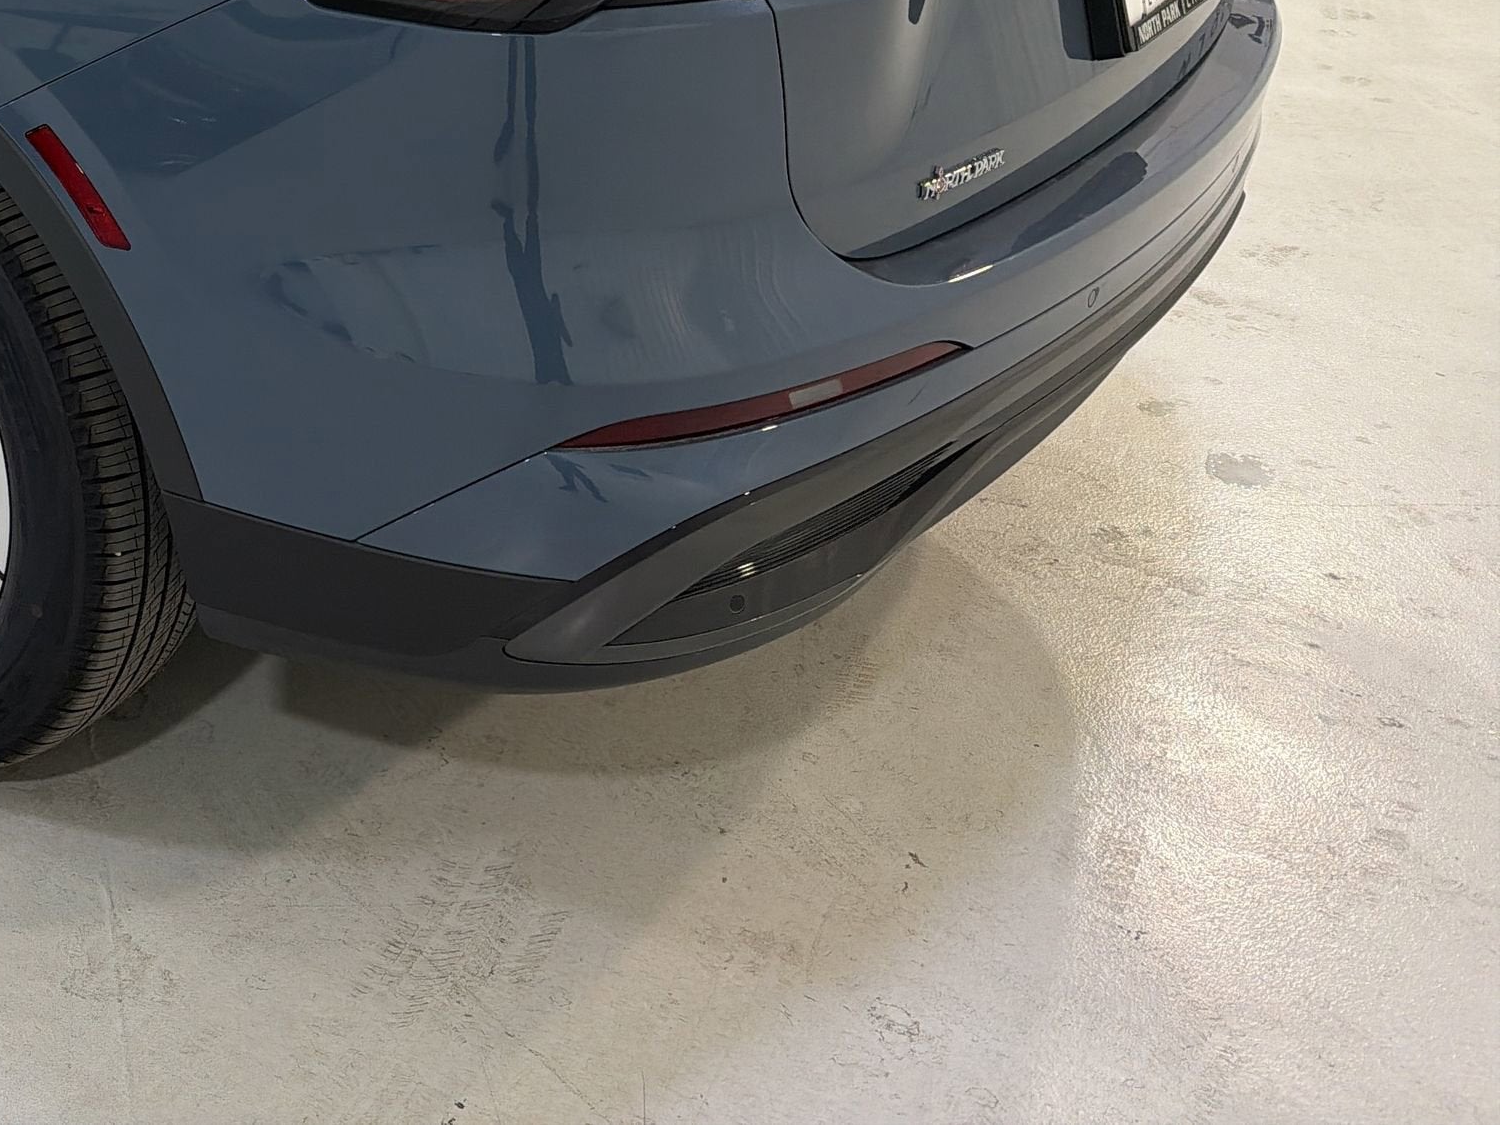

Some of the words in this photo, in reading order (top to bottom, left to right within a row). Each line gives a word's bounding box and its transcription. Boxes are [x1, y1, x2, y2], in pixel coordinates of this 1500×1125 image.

[1137, 15, 1162, 45] NORTH
[1161, 0, 1182, 27] PARK
[919, 164, 974, 201] NORTH
[972, 149, 1006, 179] PARK
